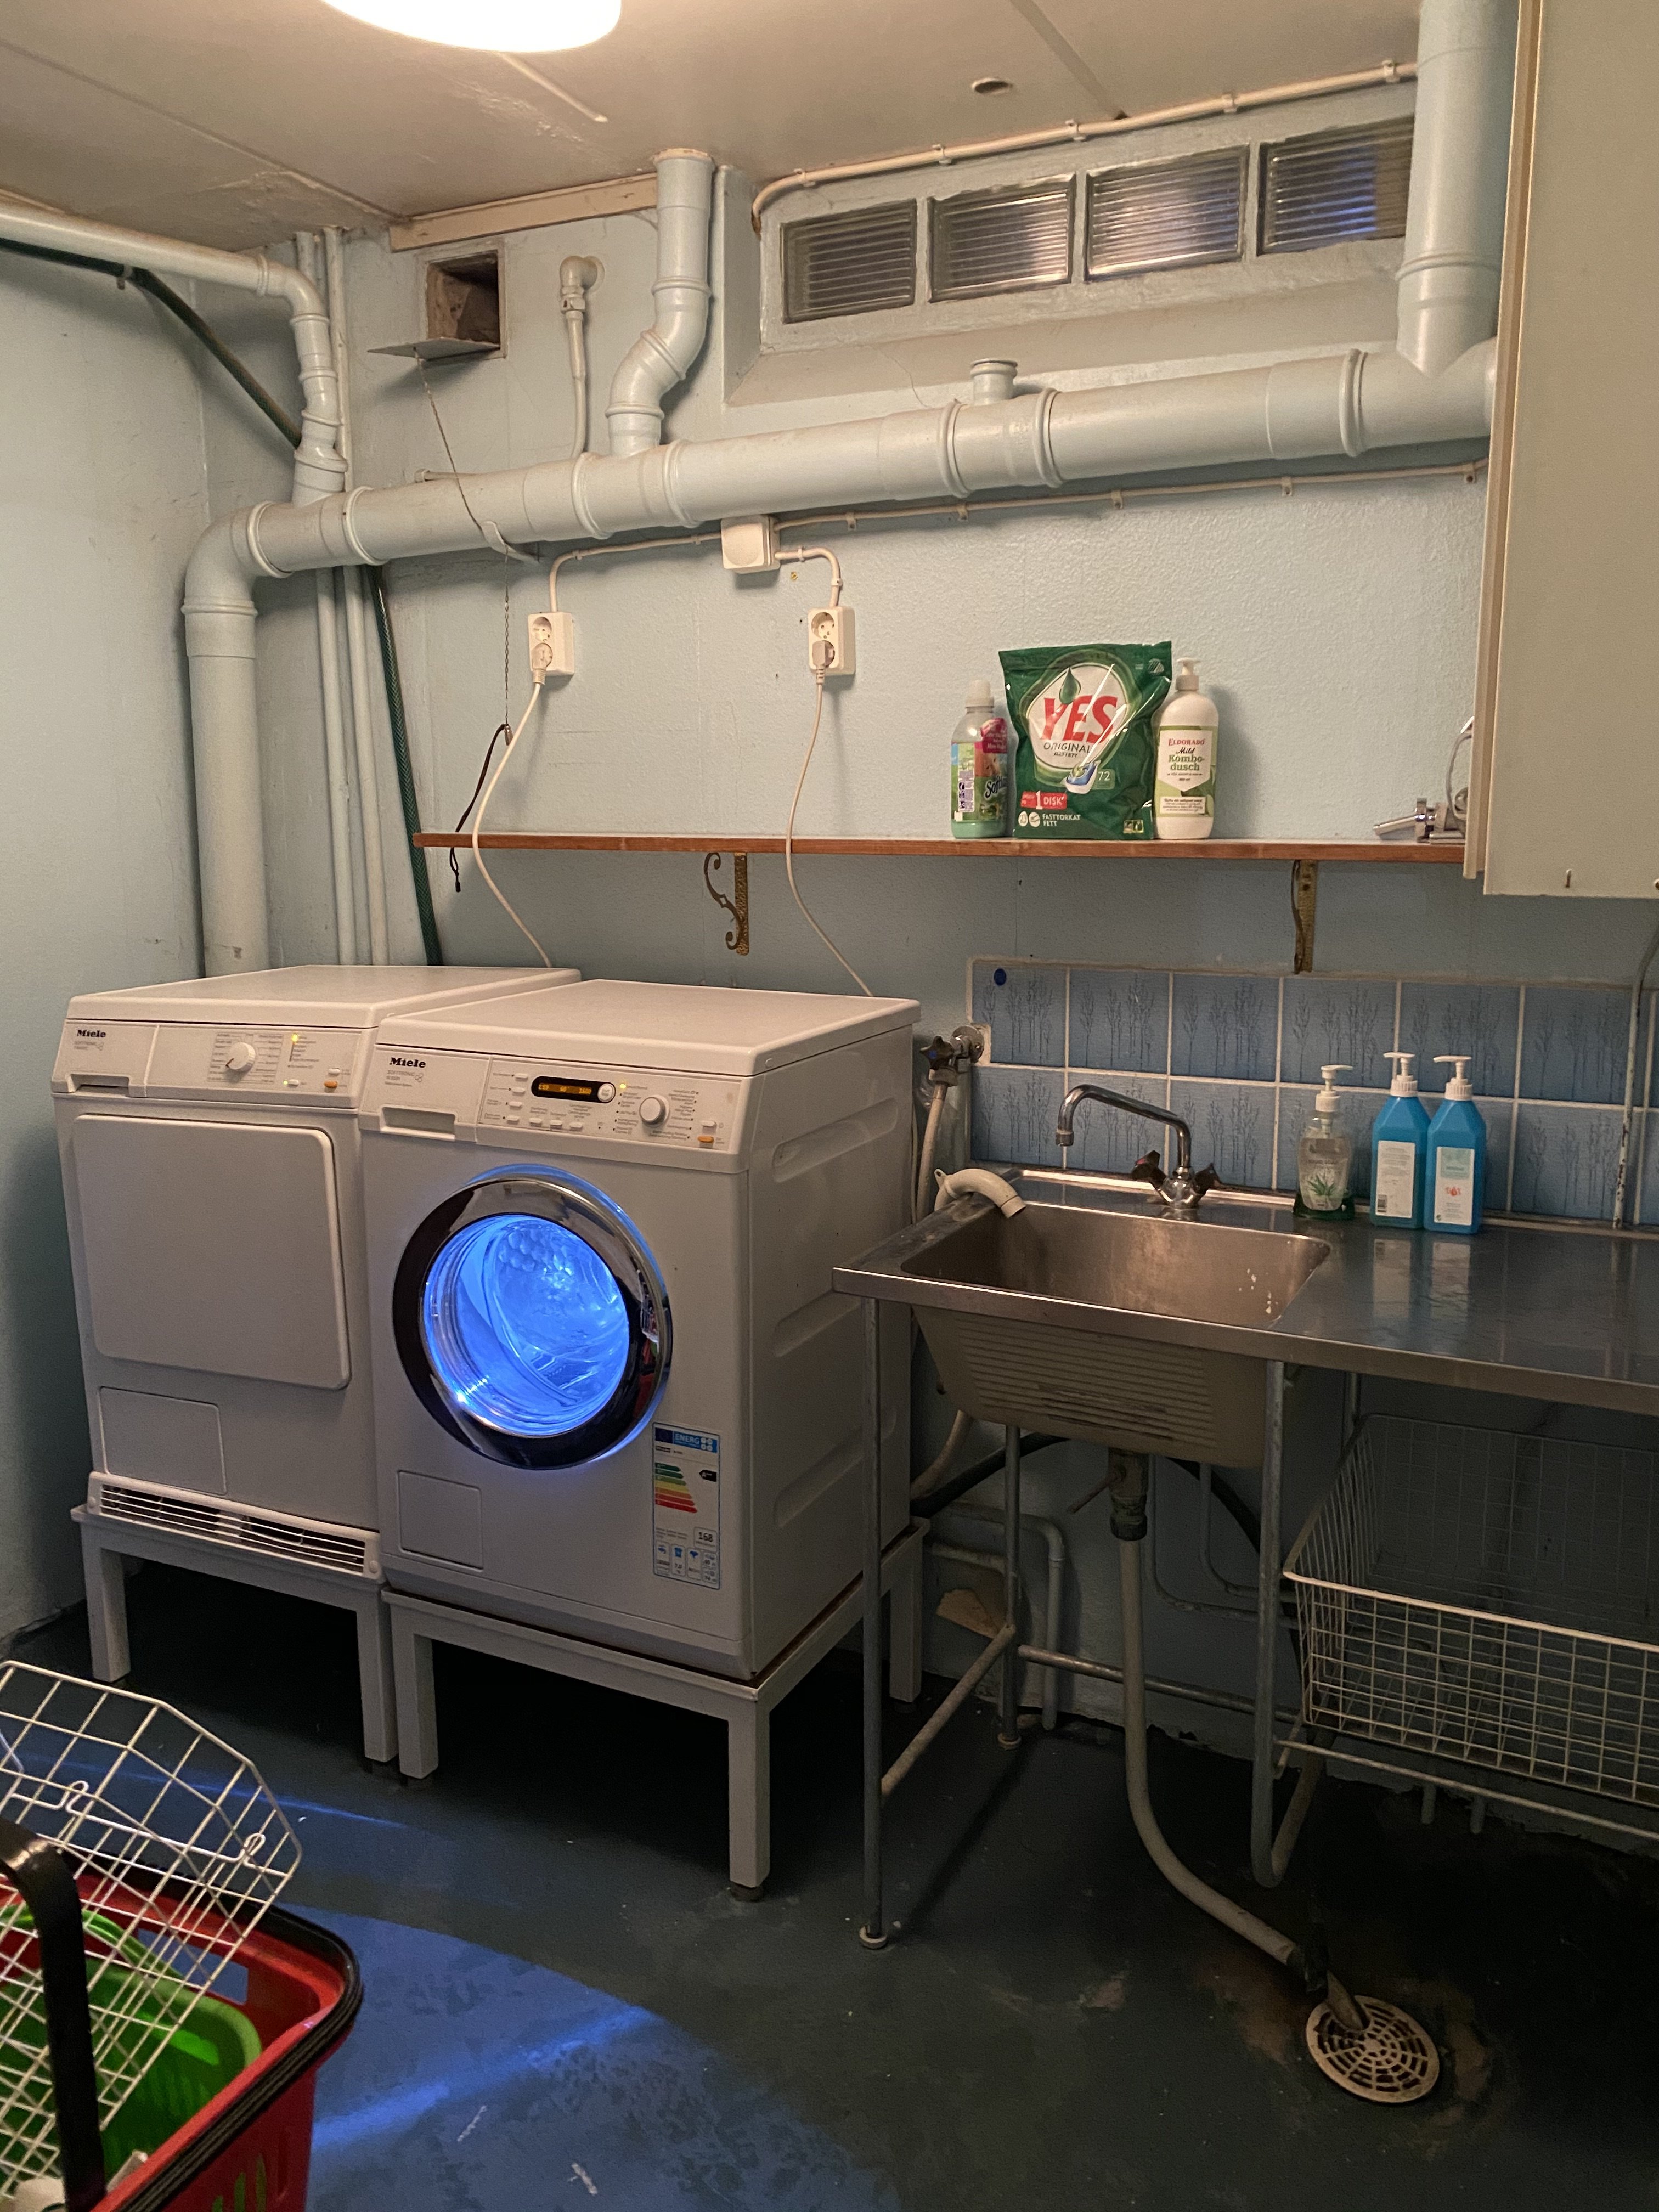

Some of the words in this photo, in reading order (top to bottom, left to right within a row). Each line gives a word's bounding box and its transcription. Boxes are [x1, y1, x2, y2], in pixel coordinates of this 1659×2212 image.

[1040, 695, 1118, 743] YES
[1043, 742, 1091, 754] ORIGINAL
[1170, 762, 1200, 771] dusch
[1098, 771, 1110, 781] 72
[1036, 790, 1043, 810] 1
[1042, 813, 1081, 821] FASTTORKAT
[77, 1029, 106, 1038] Miele
[389, 1057, 426, 1068] Miele
[675, 1433, 700, 1444] ENERG
[698, 1531, 713, 1542] 168
